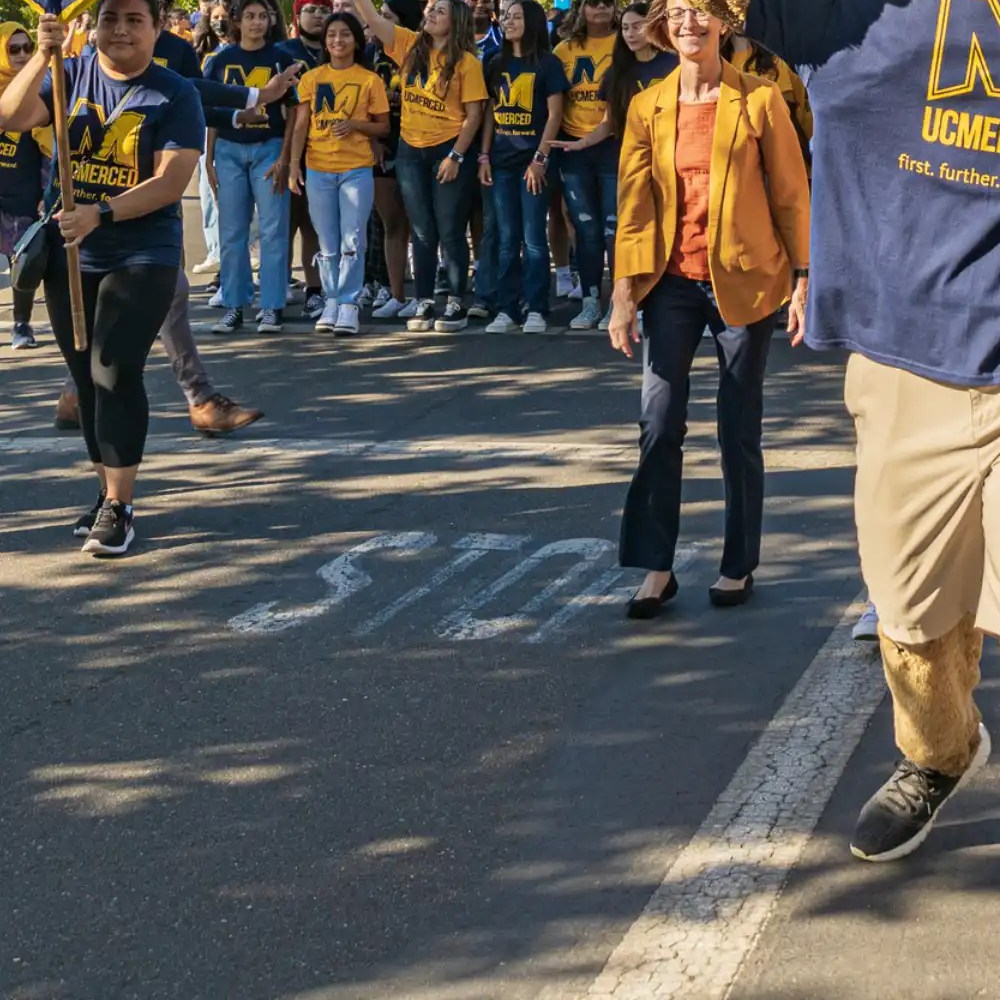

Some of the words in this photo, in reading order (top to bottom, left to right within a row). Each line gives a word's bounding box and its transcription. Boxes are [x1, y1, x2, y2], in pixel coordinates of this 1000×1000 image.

[70, 160, 139, 188] CMERCED
[898, 153, 934, 177] first.
[939, 162, 1000, 189] further.
